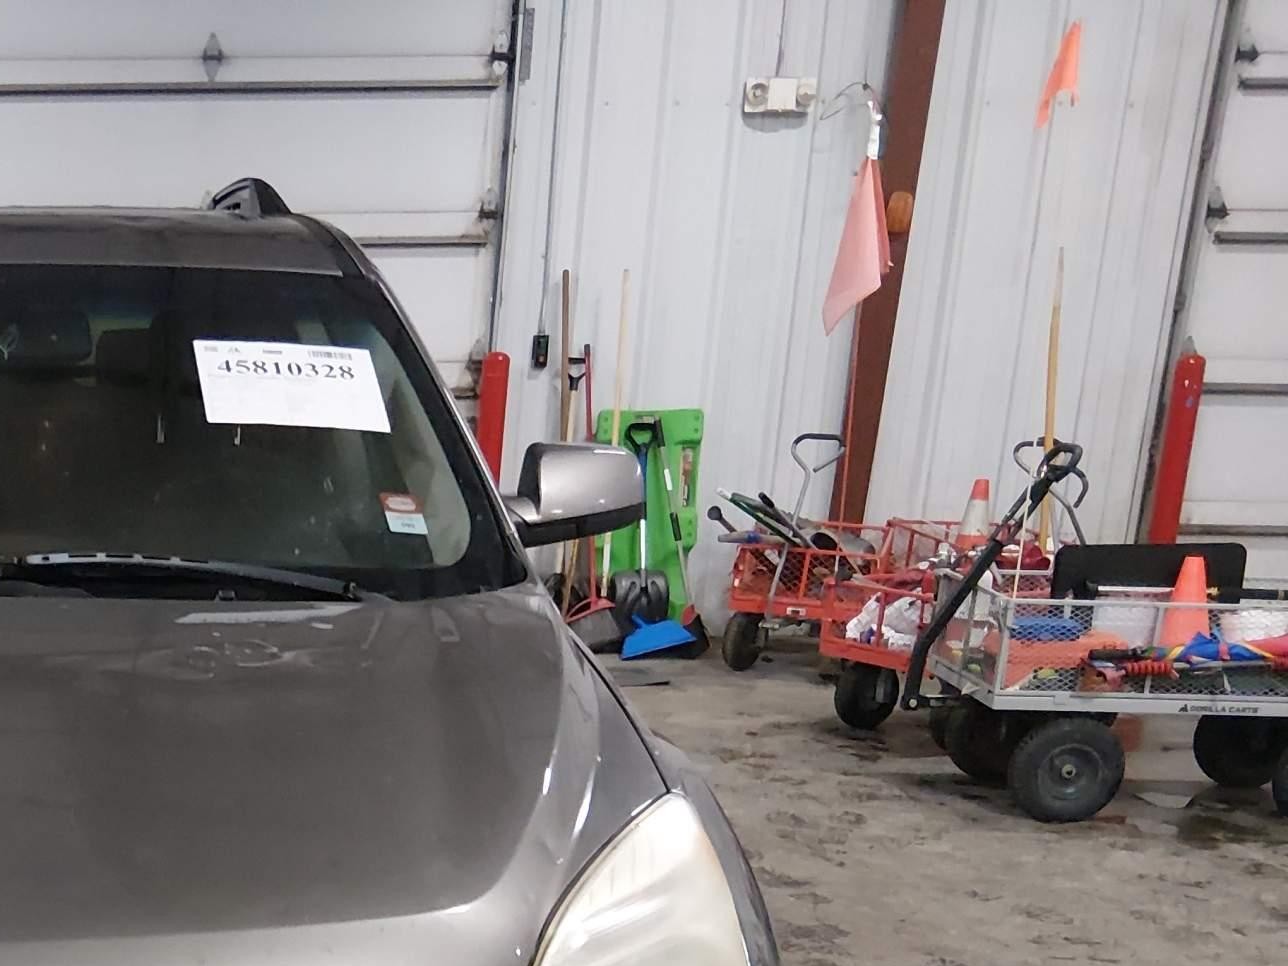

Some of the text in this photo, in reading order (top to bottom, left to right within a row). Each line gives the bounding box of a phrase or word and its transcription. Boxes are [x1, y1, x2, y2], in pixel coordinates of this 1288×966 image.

[217, 359, 355, 380] 45810328
[1189, 704, 1259, 714] GORILLA CARTS
